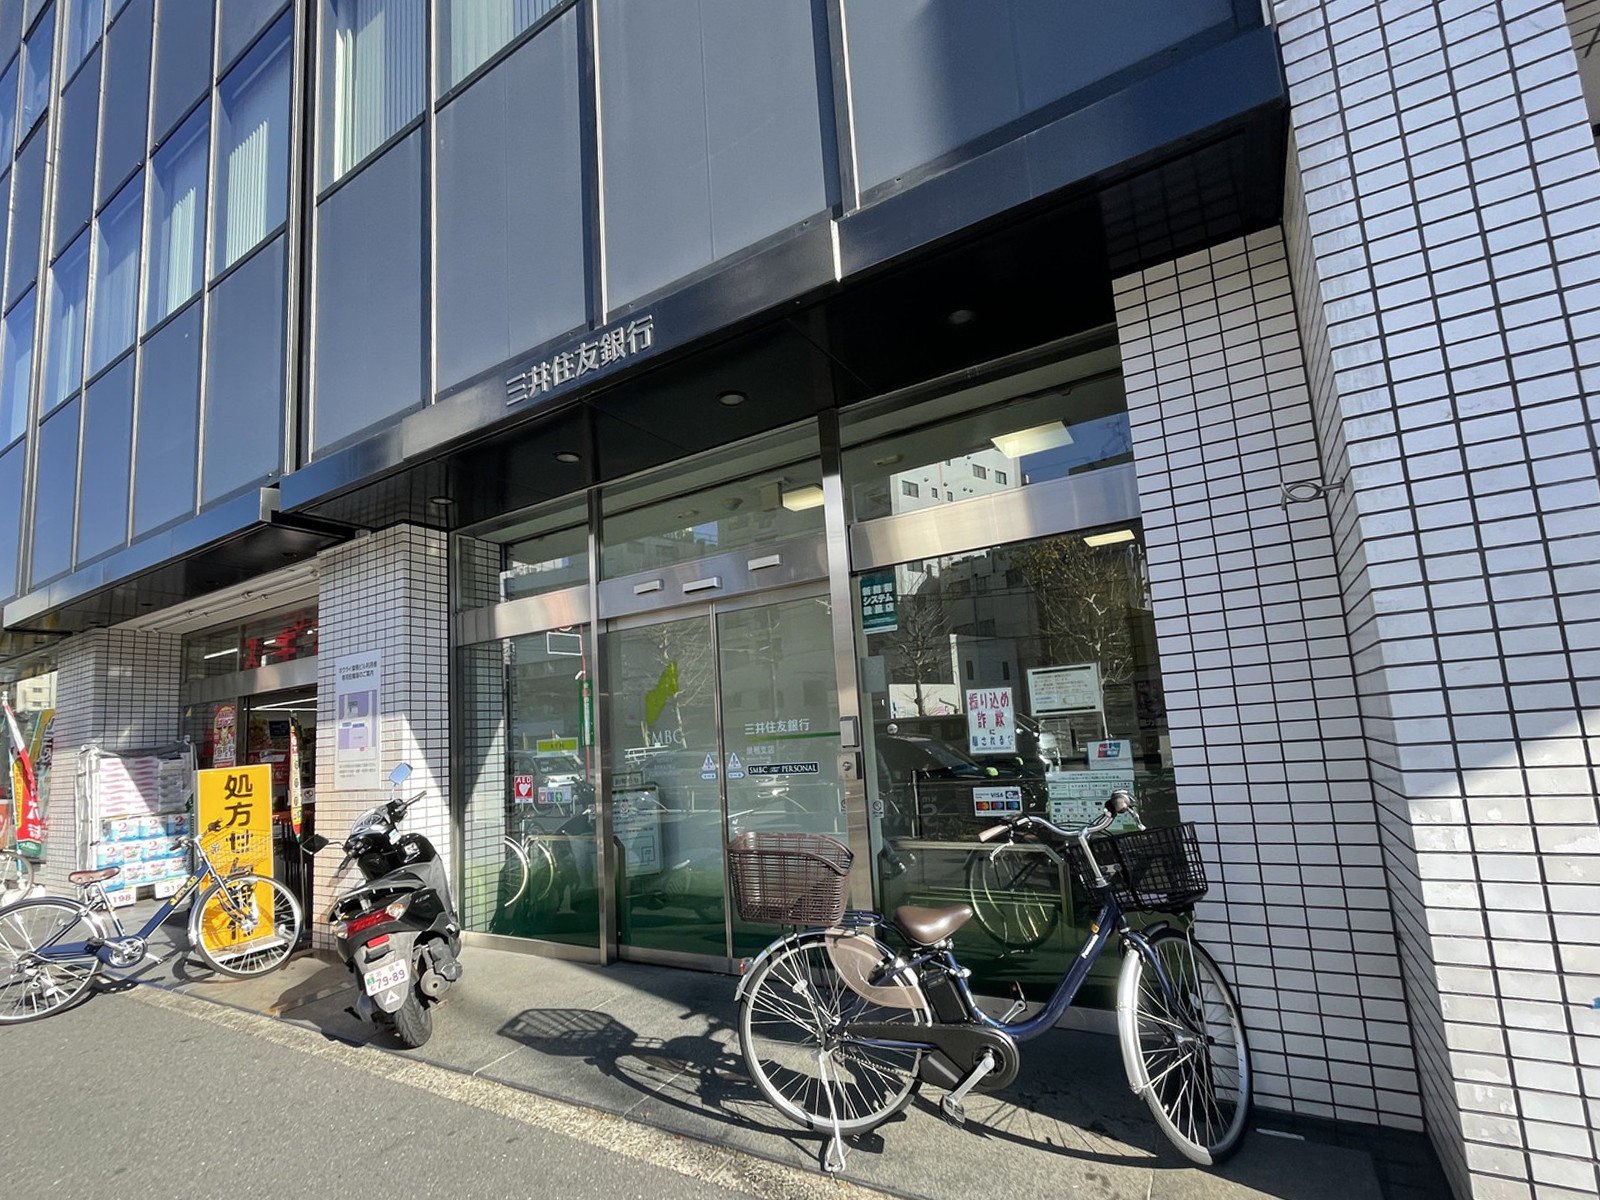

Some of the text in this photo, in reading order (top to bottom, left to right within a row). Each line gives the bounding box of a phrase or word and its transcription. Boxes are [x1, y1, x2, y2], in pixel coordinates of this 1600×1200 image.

[506, 314, 654, 406] 三井住友銀行
[968, 691, 1010, 711] 振り込め
[744, 718, 811, 735] 三井住友銀行
[989, 728, 996, 736] に
[749, 766, 768, 774] SMBC
[781, 763, 817, 773] PERSONAL
[516, 776, 531, 784] AED
[222, 773, 254, 941] 処方せん
[112, 893, 132, 903] 198
